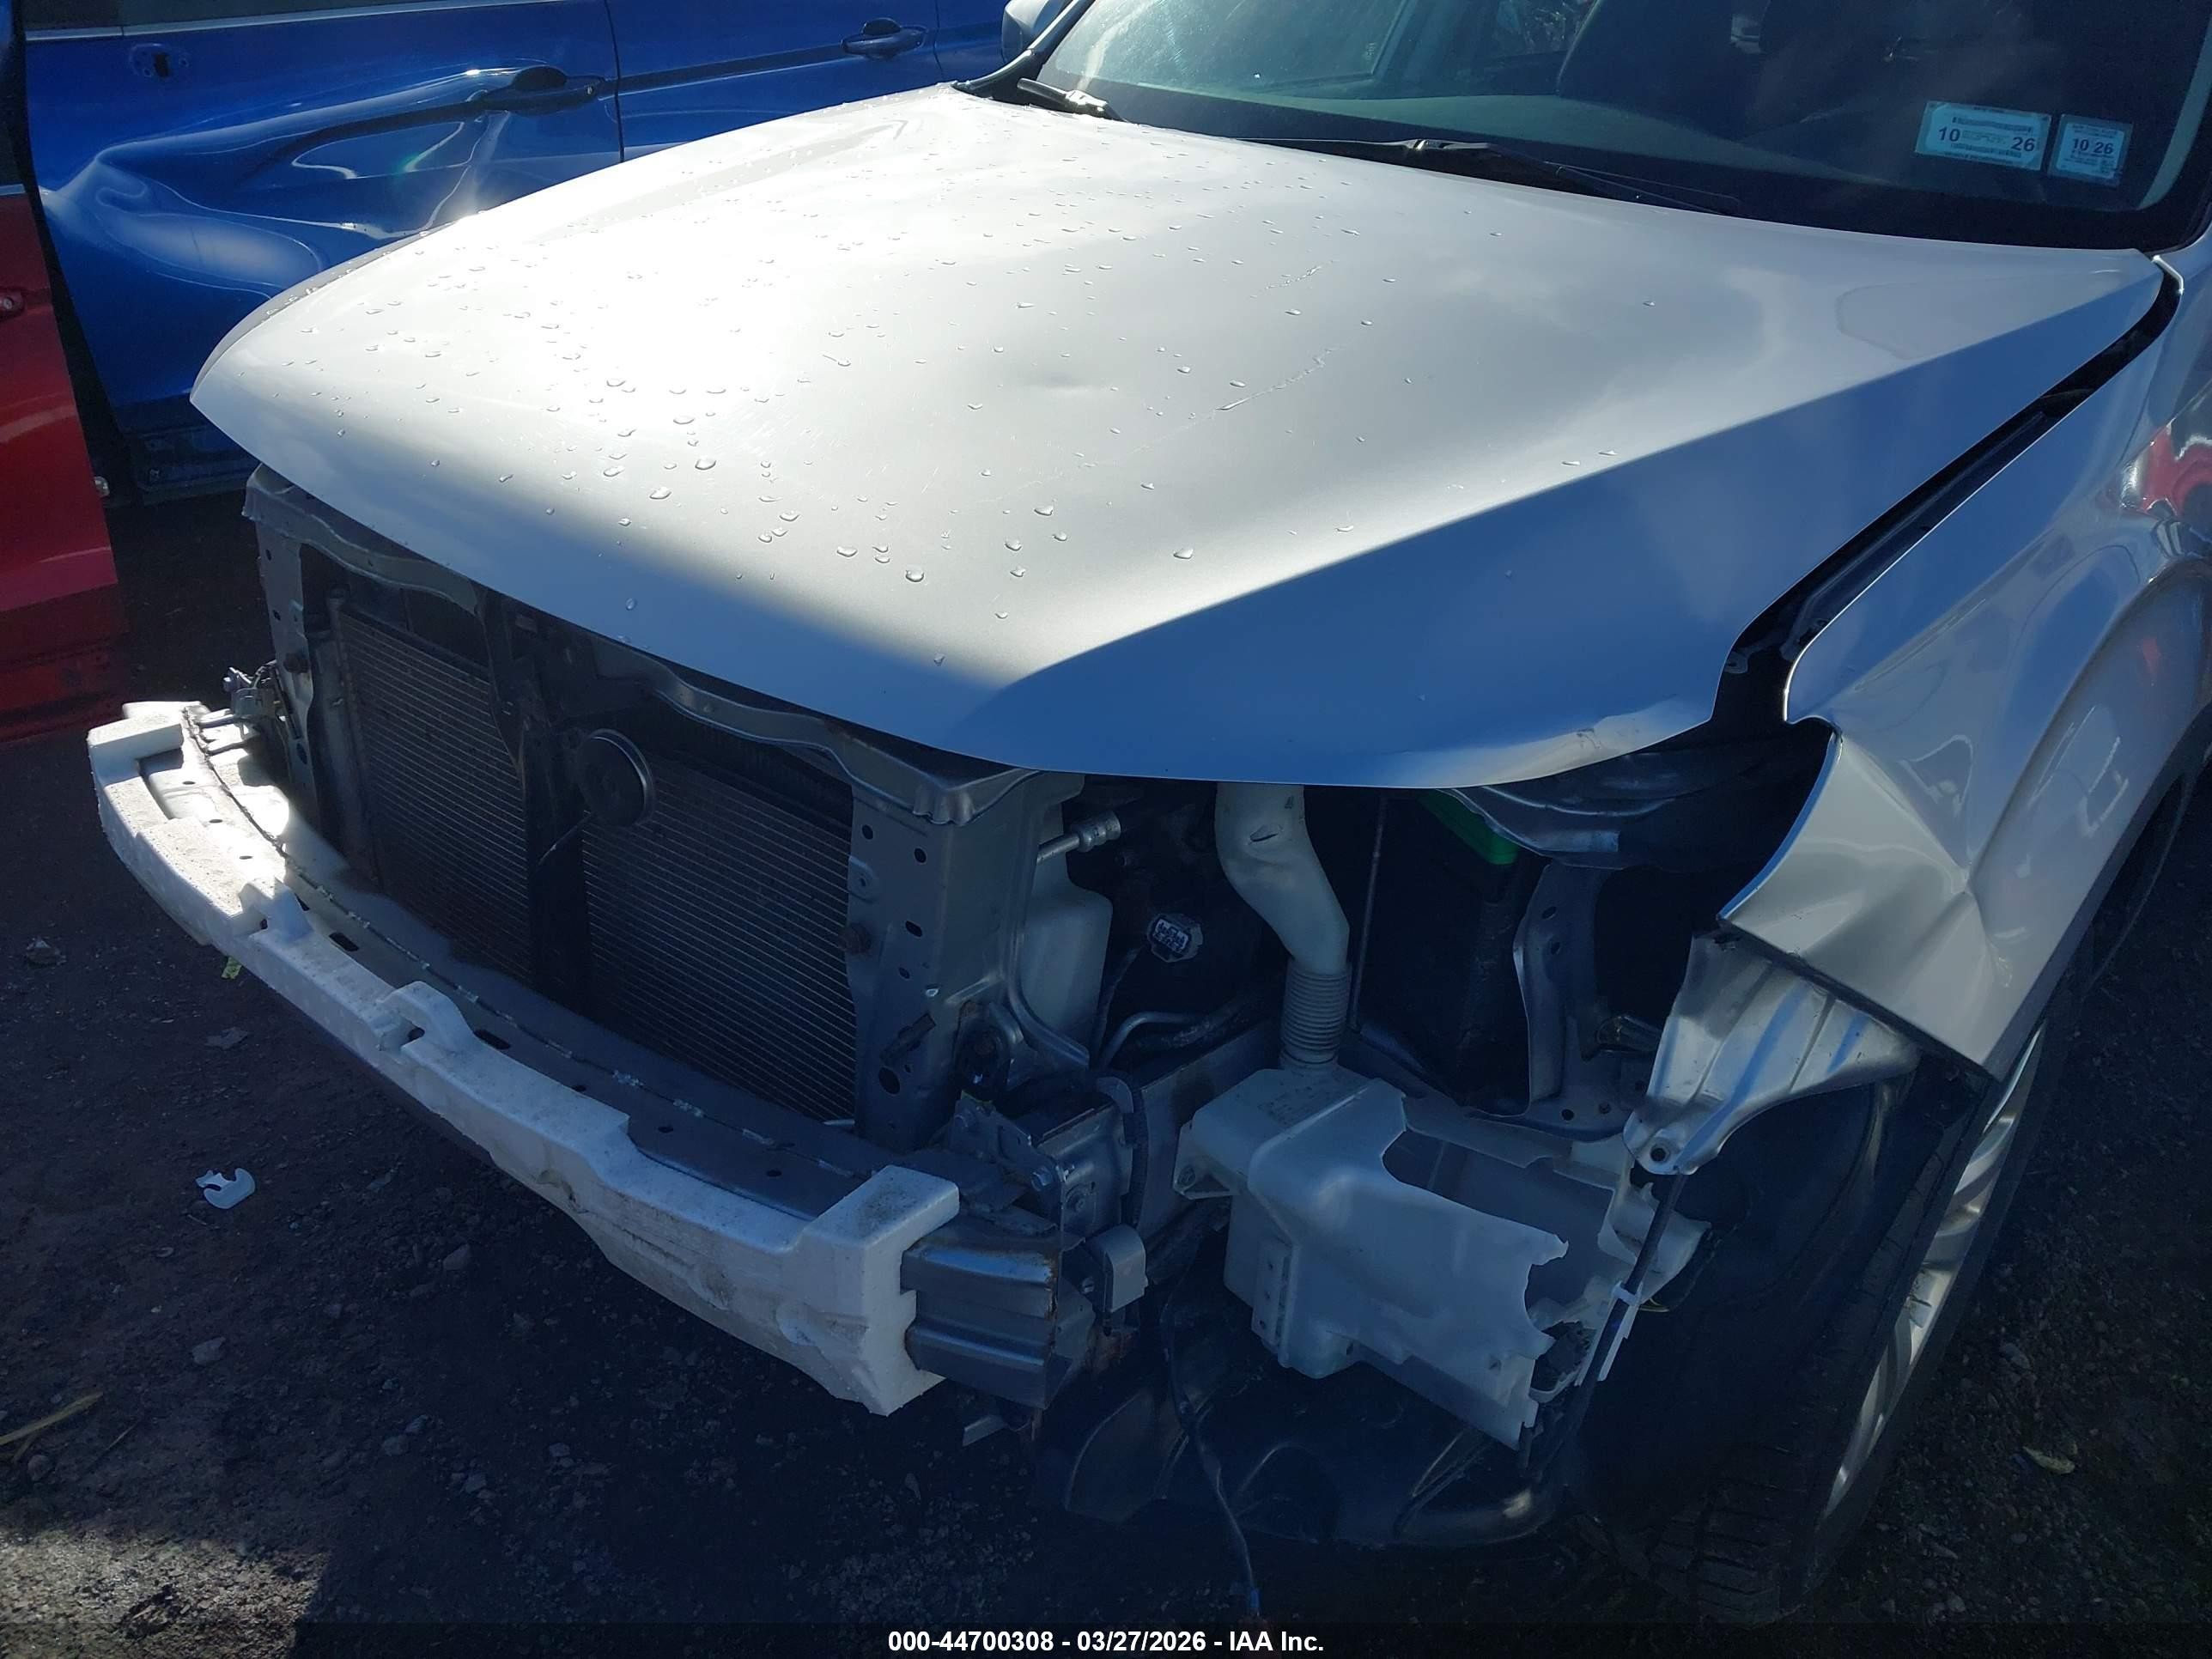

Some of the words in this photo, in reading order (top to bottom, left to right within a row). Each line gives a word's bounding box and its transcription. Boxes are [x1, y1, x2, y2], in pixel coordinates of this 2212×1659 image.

[1938, 126, 1961, 143] 10
[2010, 136, 2037, 153] 26
[2073, 138, 2089, 152] 10
[2094, 141, 2114, 155] 26
